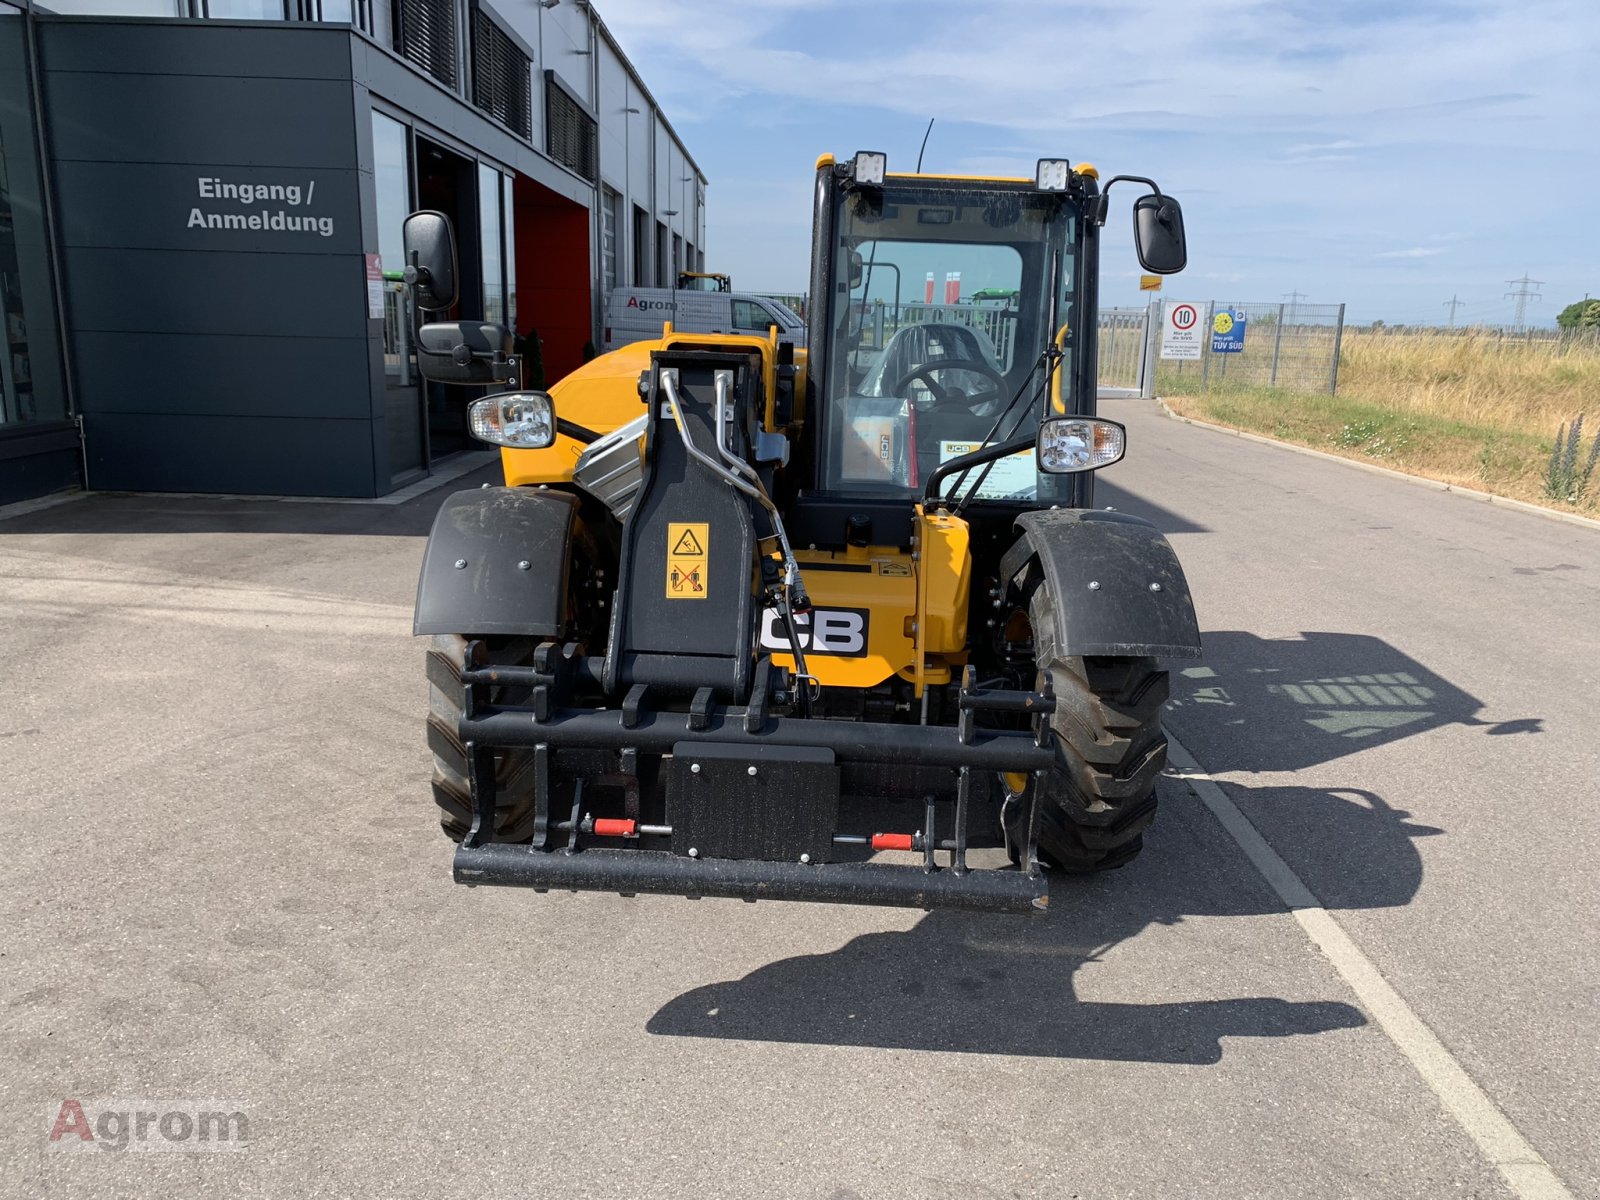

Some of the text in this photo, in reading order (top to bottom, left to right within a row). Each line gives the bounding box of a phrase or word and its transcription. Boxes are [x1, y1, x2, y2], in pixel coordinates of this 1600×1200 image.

[198, 177, 315, 205] Eingang /
[187, 208, 334, 237] Anmeldung
[627, 296, 678, 311] Agrom
[1179, 310, 1190, 324] 10
[1213, 341, 1243, 350] TÜV SÜD
[881, 435, 889, 459] JCB
[947, 444, 970, 452] JCB
[760, 607, 864, 653] CB
